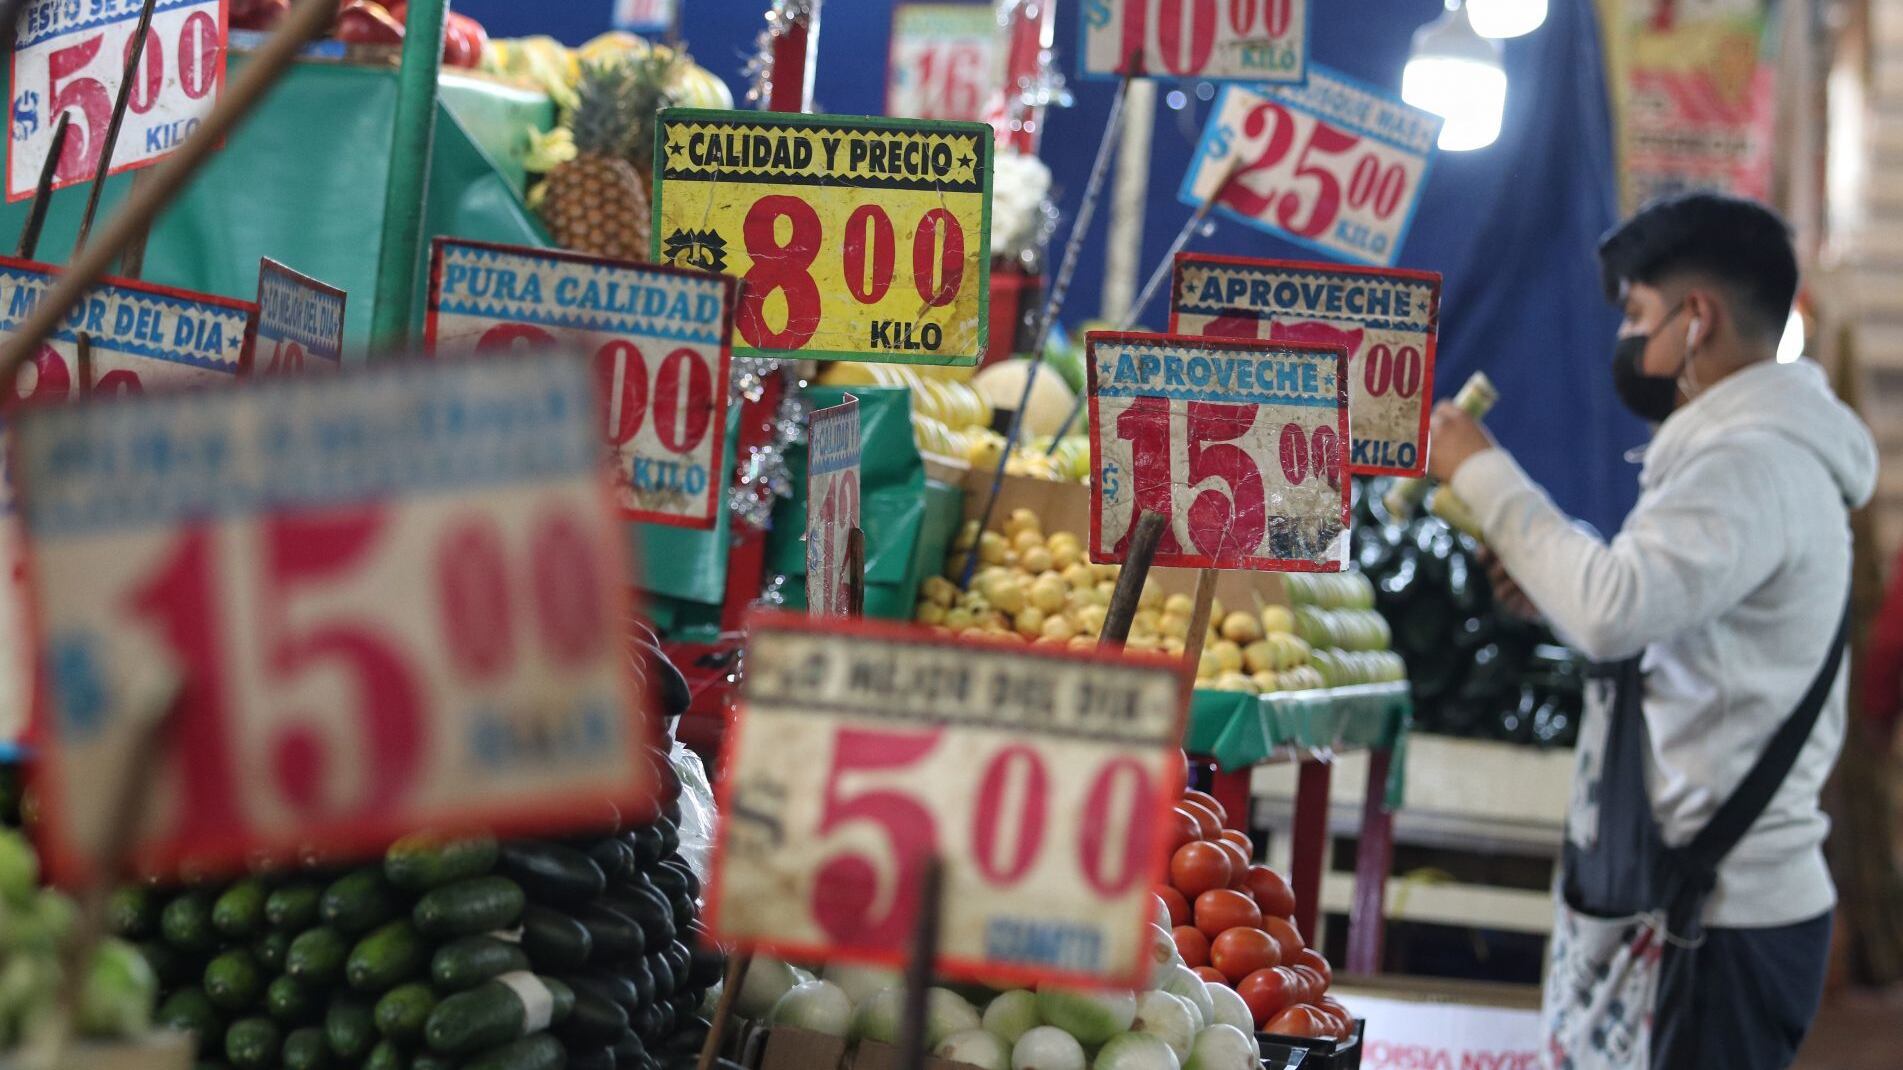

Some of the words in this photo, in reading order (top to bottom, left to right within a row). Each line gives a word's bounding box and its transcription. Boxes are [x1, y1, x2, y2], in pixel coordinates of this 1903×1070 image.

[1241, 48, 1296, 70] KILO
[688, 131, 812, 170] CALIDAD
[825, 137, 841, 170] Y
[850, 139, 953, 177] PRECIO
[442, 262, 542, 304] PURA
[555, 275, 720, 326] CALIDAD
[1198, 275, 1412, 318] APROVECHE
[8, 283, 107, 333] MOR
[114, 303, 164, 344] DEL
[173, 316, 223, 355] DIA
[870, 320, 942, 351] KILO
[1112, 353, 1319, 393] APROVECHE
[1351, 439, 1416, 469] KILO
[632, 456, 706, 496] KILO
